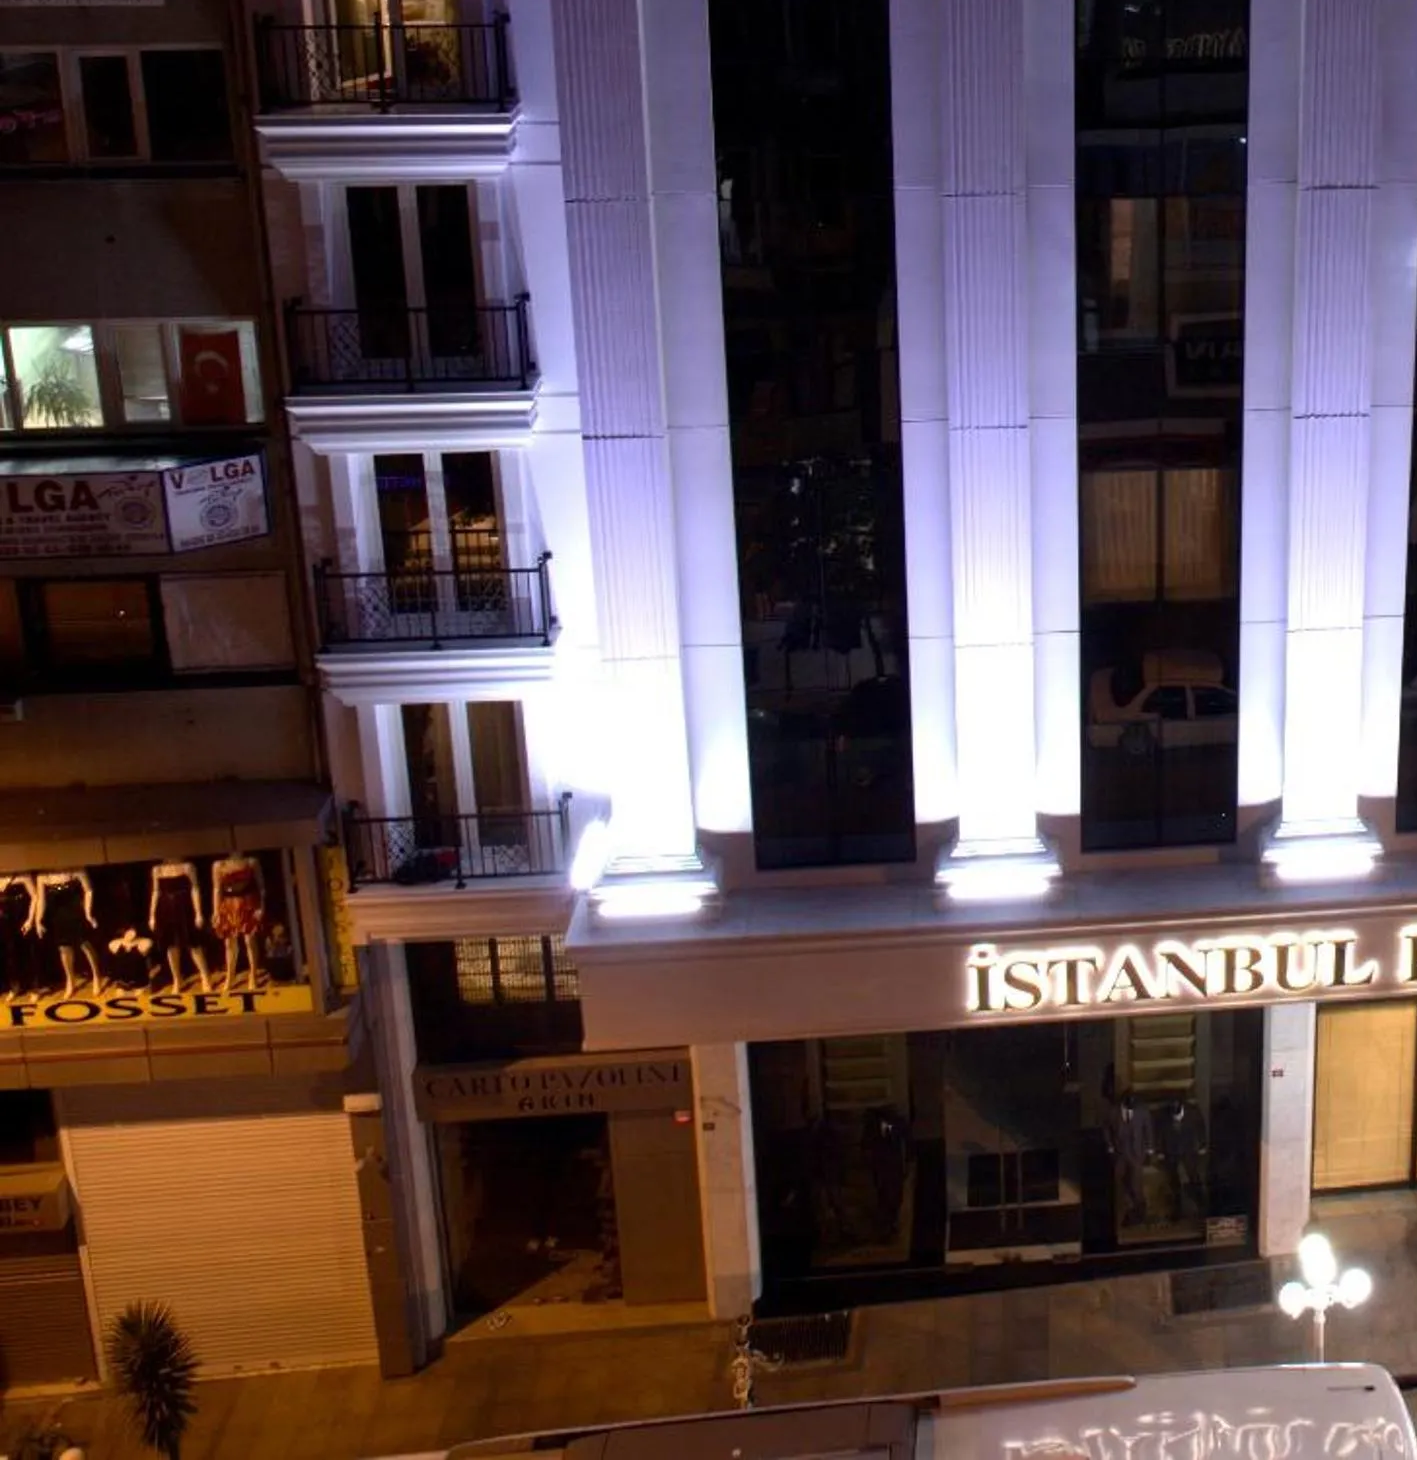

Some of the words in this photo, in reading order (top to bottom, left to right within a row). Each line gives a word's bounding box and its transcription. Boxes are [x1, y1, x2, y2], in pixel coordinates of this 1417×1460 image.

[6, 480, 99, 513] LGA
[970, 939, 1375, 1011] İSTANBUL
[9, 991, 265, 1026] FOSSET
